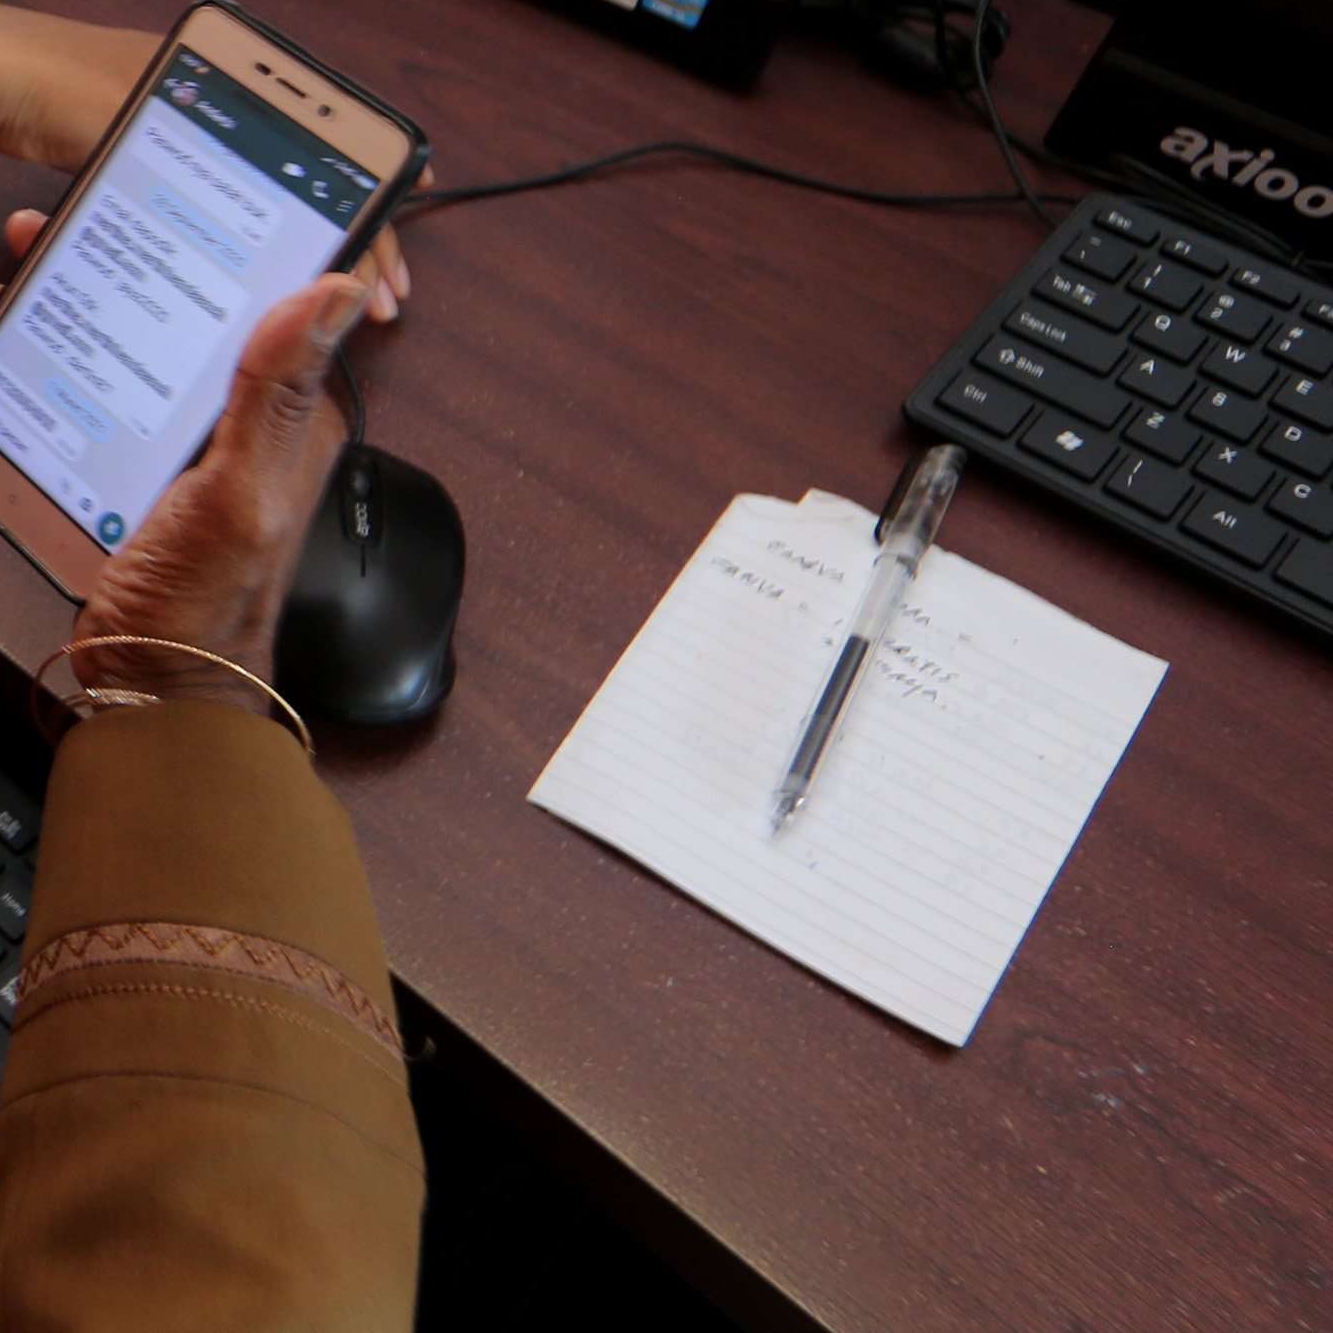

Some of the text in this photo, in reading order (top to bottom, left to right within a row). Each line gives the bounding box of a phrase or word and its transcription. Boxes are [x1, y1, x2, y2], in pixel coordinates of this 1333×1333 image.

[1160, 125, 1333, 218] axioo
[1154, 314, 1172, 332] Q
[1225, 345, 1247, 364] W
[1139, 358, 1156, 376] A
[1295, 378, 1314, 396] E
[1145, 411, 1166, 430] Z
[1284, 425, 1303, 442] D
[1218, 446, 1238, 465] X
[1293, 483, 1313, 500] C
[0, 891, 28, 918] Home
